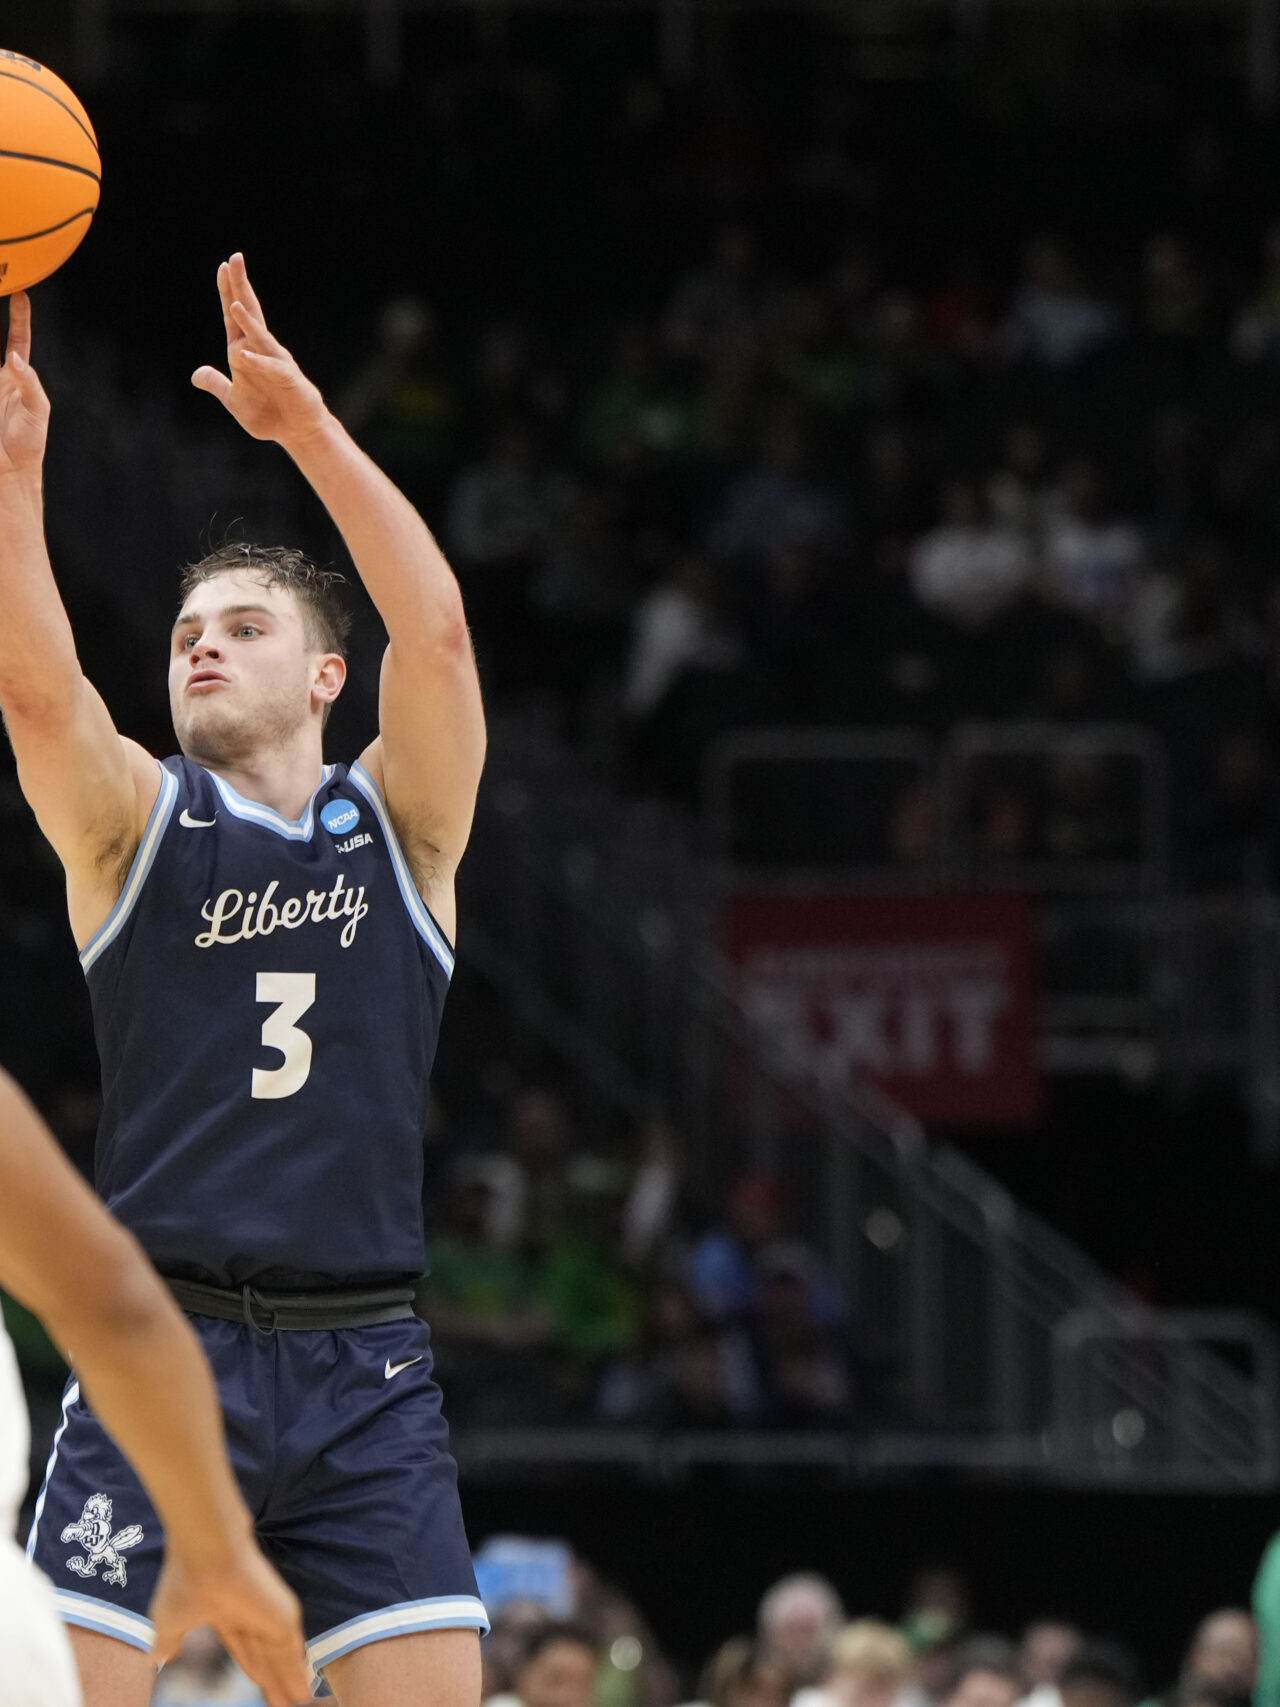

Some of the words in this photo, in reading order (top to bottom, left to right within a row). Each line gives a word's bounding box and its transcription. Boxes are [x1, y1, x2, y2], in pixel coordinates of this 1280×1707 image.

[328, 809, 359, 830] NCAA
[343, 833, 373, 853] USA
[194, 873, 368, 948] Liberty
[251, 972, 316, 1099] 3
